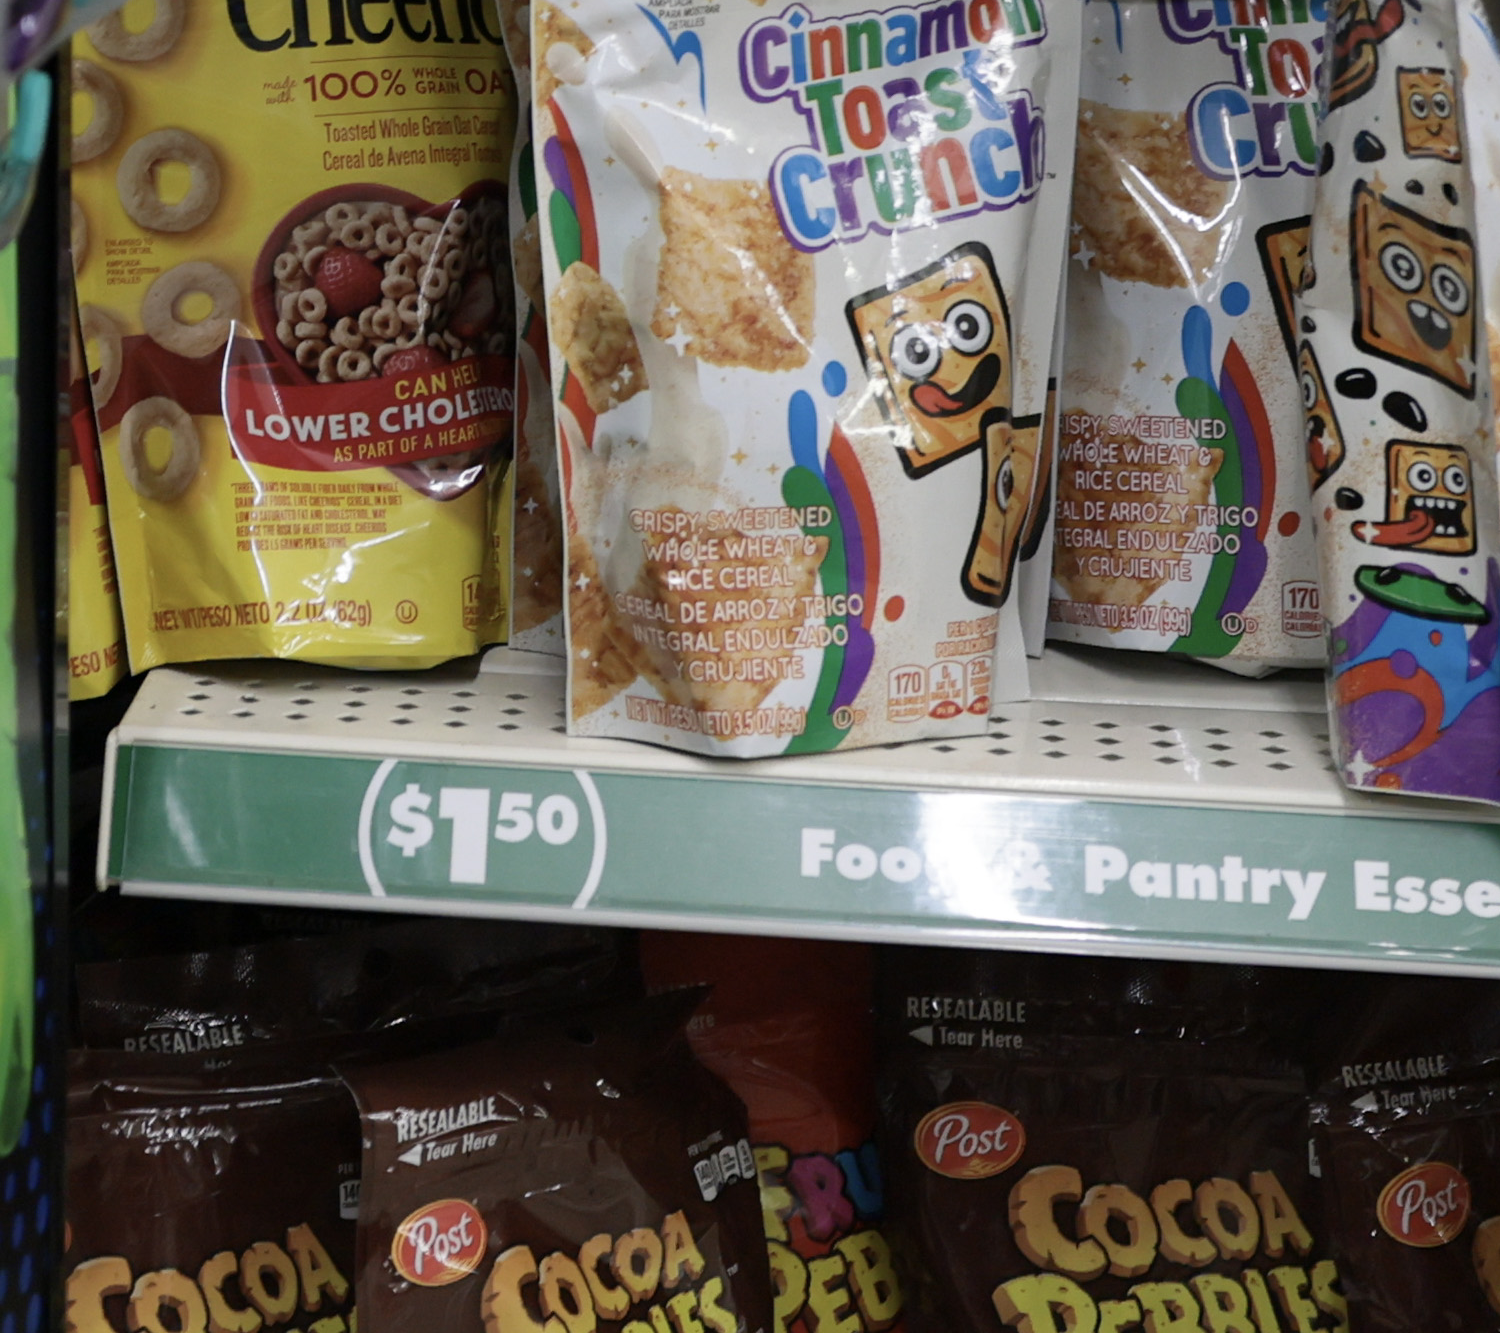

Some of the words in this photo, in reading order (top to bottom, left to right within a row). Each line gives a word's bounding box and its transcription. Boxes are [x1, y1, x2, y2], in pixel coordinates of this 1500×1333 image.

[303, 68, 407, 102] 100%
[412, 66, 459, 82] WHOLE
[414, 79, 462, 96] GRAIN
[806, 51, 1010, 155] Toast
[323, 120, 378, 143] Toasted
[380, 118, 421, 141] Whole
[423, 116, 453, 139] Grain
[454, 116, 473, 138] Oat
[322, 148, 367, 173] Cereal
[368, 147, 385, 168] de
[387, 145, 428, 168] Avena
[429, 142, 472, 167] Integral
[783, 95, 1047, 238] Crunch
[245, 408, 370, 443] LOWER
[380, 388, 515, 435] CHOLESTERO
[629, 509, 703, 533] CRISPY,
[706, 506, 832, 530] SWEETENED
[645, 537, 720, 562] WHOLE
[725, 537, 797, 560] WHEAT
[802, 536, 817, 557] &
[667, 568, 714, 591] RICE
[719, 565, 794, 588] CEREAL
[616, 595, 676, 622] CEREAL
[681, 595, 709, 619] DE
[713, 594, 781, 619] ARROZ
[783, 594, 798, 618] Y
[802, 593, 864, 617] TRIGO
[633, 626, 721, 653] INTEGRAL
[725, 623, 849, 649] ENDULZADO
[687, 656, 805, 682] CRUJIENTE
[893, 671, 923, 695] 170
[1085, 841, 1326, 924] Pantry
[932, 1113, 1011, 1164] Post
[1008, 1164, 1316, 1282] COCOA
[65, 1221, 350, 1333] COCOA
[482, 1207, 704, 1333] COCOA
